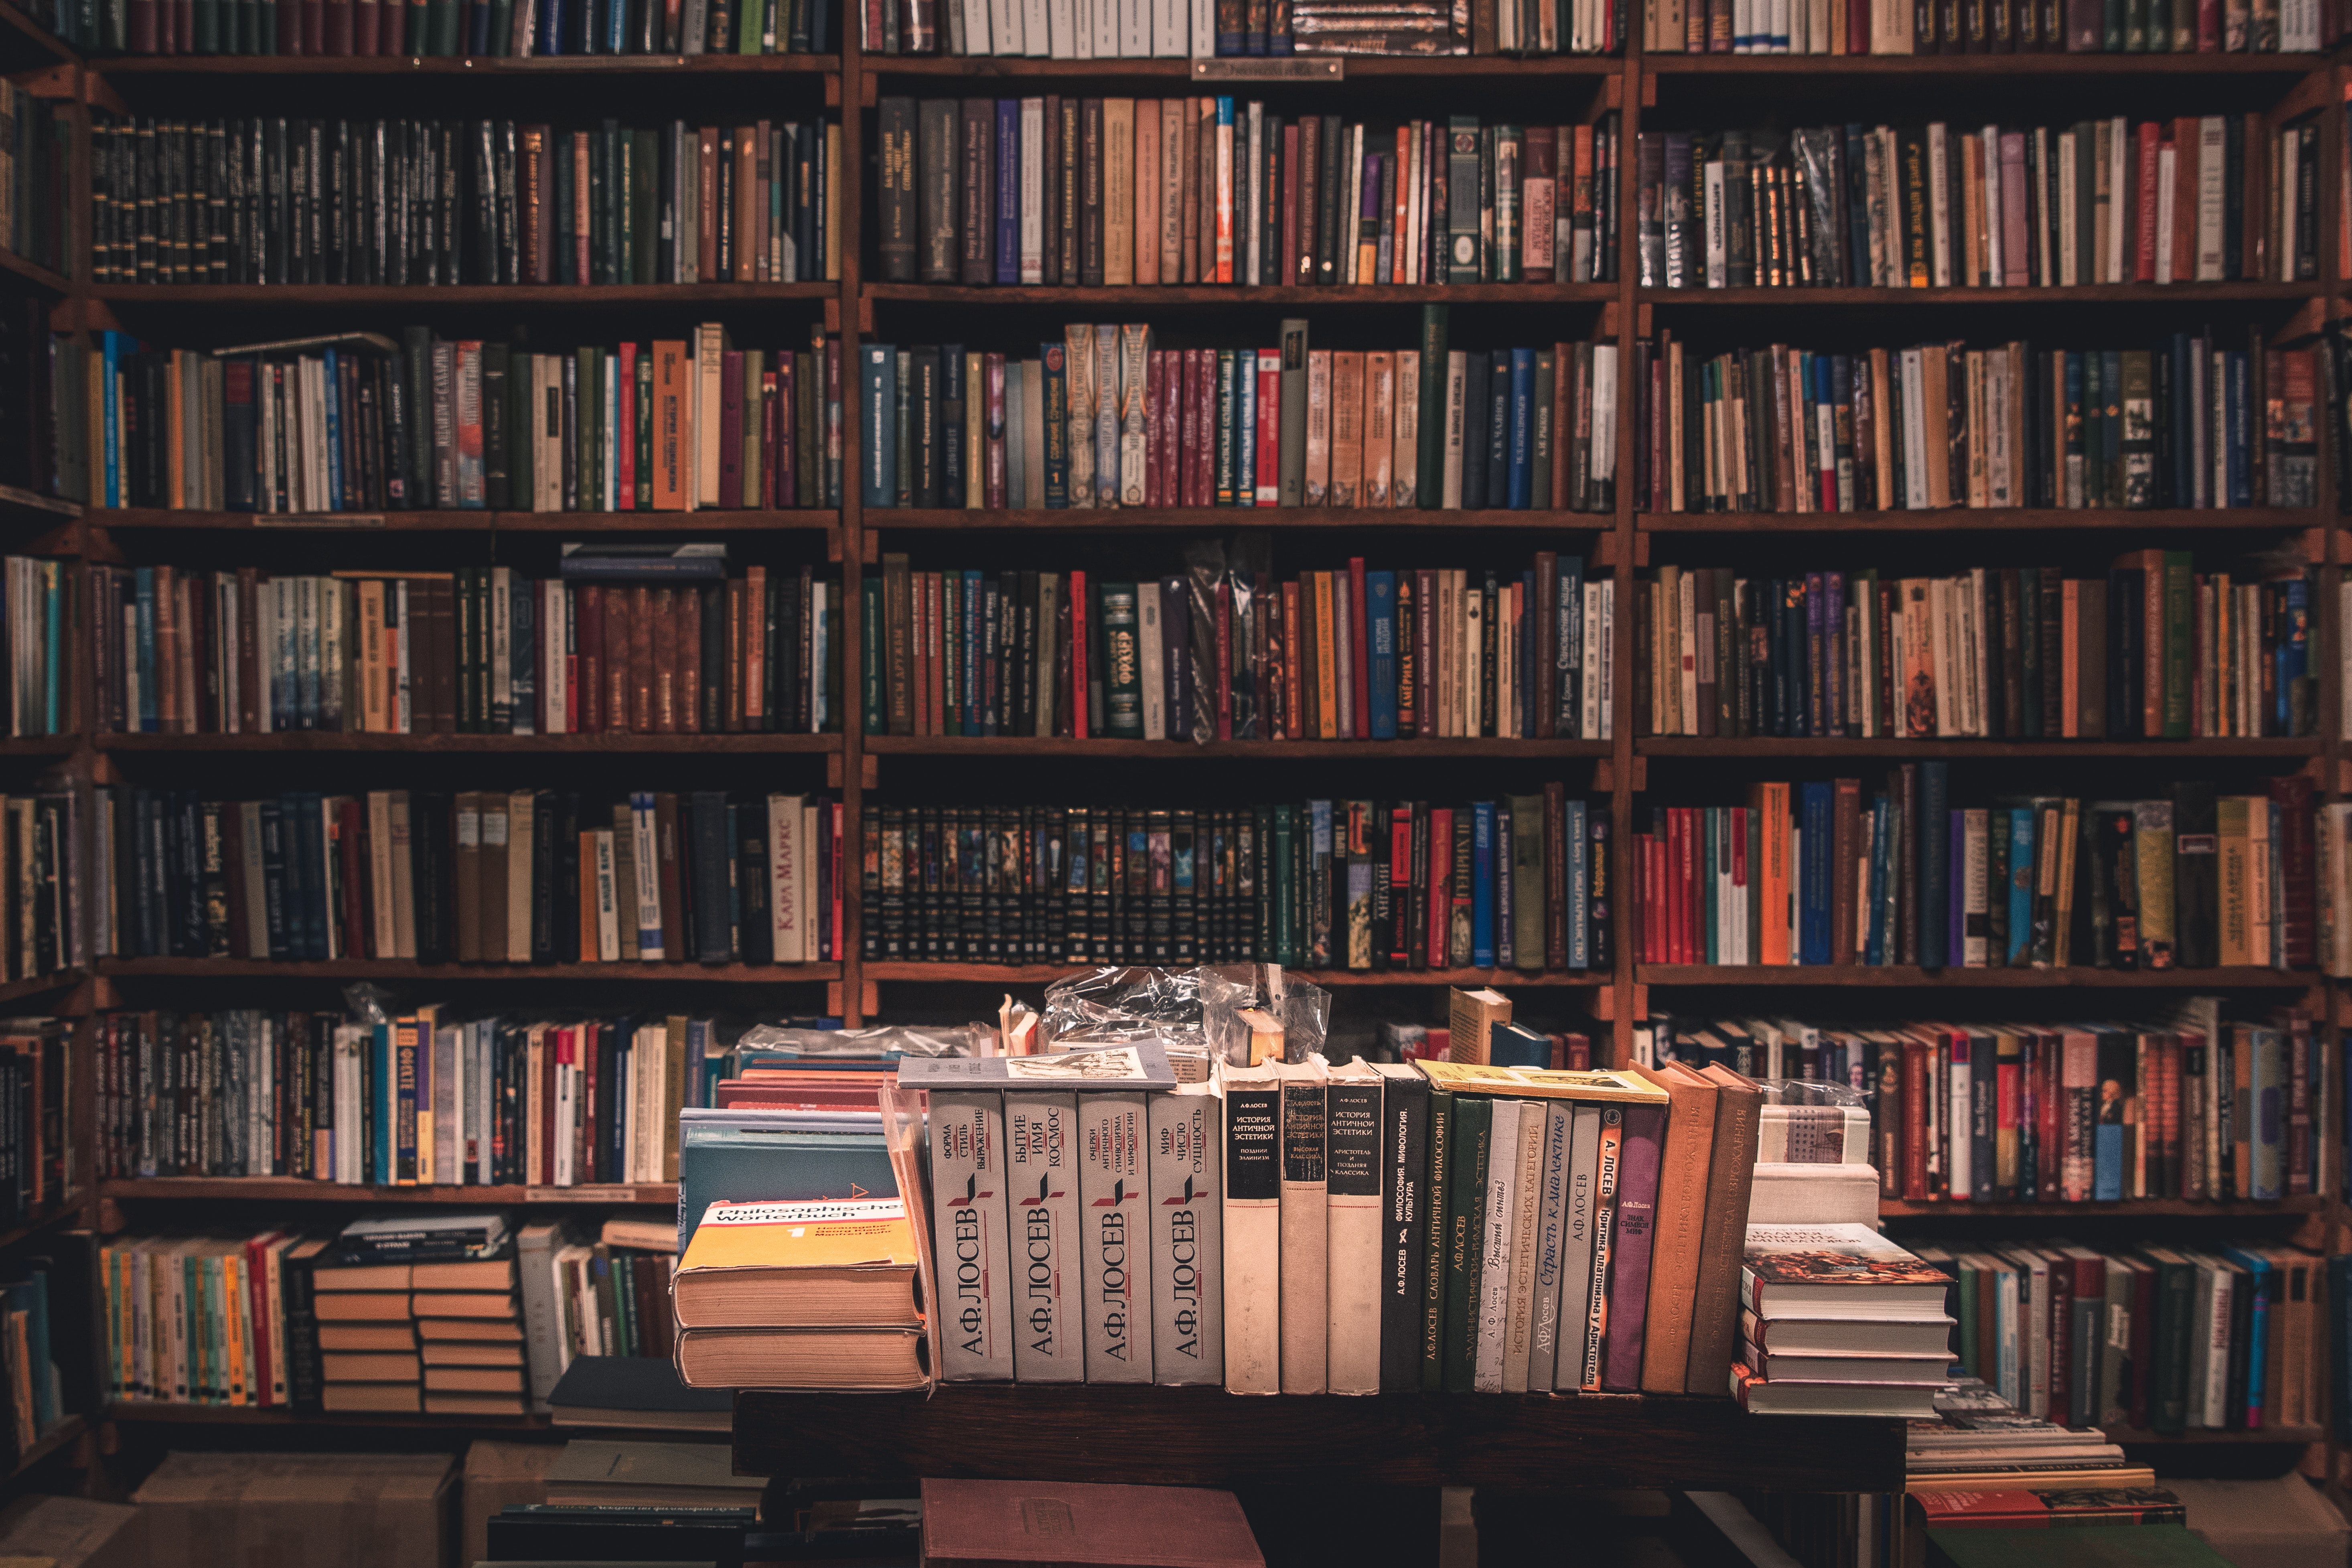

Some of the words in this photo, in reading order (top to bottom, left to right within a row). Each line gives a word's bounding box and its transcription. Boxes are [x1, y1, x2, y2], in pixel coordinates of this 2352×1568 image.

[943, 1124, 953, 1159] ФОРМА
[959, 1124, 969, 1158] СТИЛЬ
[975, 1108, 986, 1170] ВЫРАЖЕНИЕ
[1014, 1115, 1027, 1163] БЫТИЕ
[1032, 1122, 1043, 1154] ИМЯ
[1048, 1108, 1060, 1167] КОСМОС
[1127, 1112, 1135, 1166] МИФОЛОГИИ
[1161, 1128, 1169, 1155] МИФ
[1176, 1122, 1186, 1161] ЧИСЛО
[1192, 1109, 1203, 1173] СУЩНОСТЬ
[1397, 1108, 1407, 1163] МИФОЛОГИЯ.
[1433, 1112, 1445, 1181] ФИЛОСОФИИ
[1475, 1130, 1486, 1188] ЭСТЕТИКА
[1524, 1124, 1539, 1193] КАТЕГОРИЙ
[1606, 1140, 1616, 1152] А.
[1727, 1108, 1747, 1205] ВОЗРОЖДЕНИЯ
[1396, 1165, 1405, 1222] ФИЛОСОФИЯ.
[1494, 1179, 1505, 1218] синтез
[1602, 1156, 1615, 1195] ЛОСЕВ
[716, 1211, 855, 1221] Wörterbuch
[1405, 1181, 1414, 1222] КУЛЬТУРА
[1431, 1186, 1442, 1248] АНТИЧНОЙ
[1547, 1208, 1556, 1219] к
[1620, 1221, 1649, 1229] СИМВОЛ
[787, 1227, 805, 1237] 1
[1487, 1222, 1503, 1270] Высший
[1517, 1196, 1533, 1294] ЭСТЕТИЧЕСКИХ
[1539, 1223, 1558, 1286] Страсть
[1596, 1209, 1610, 1252] Критика
[1675, 1206, 1691, 1273] ЭСТЕТИКА
[1720, 1208, 1736, 1276] ЭСТЕТИКА
[1429, 1252, 1440, 1300] СЛОВАРЬ
[1489, 1287, 1498, 1312] Лосев
[1592, 1254, 1606, 1314] платонизма
[1513, 1298, 1527, 1355] ИСТОРИЯ
[1586, 1325, 1600, 1385] Аристотеля
